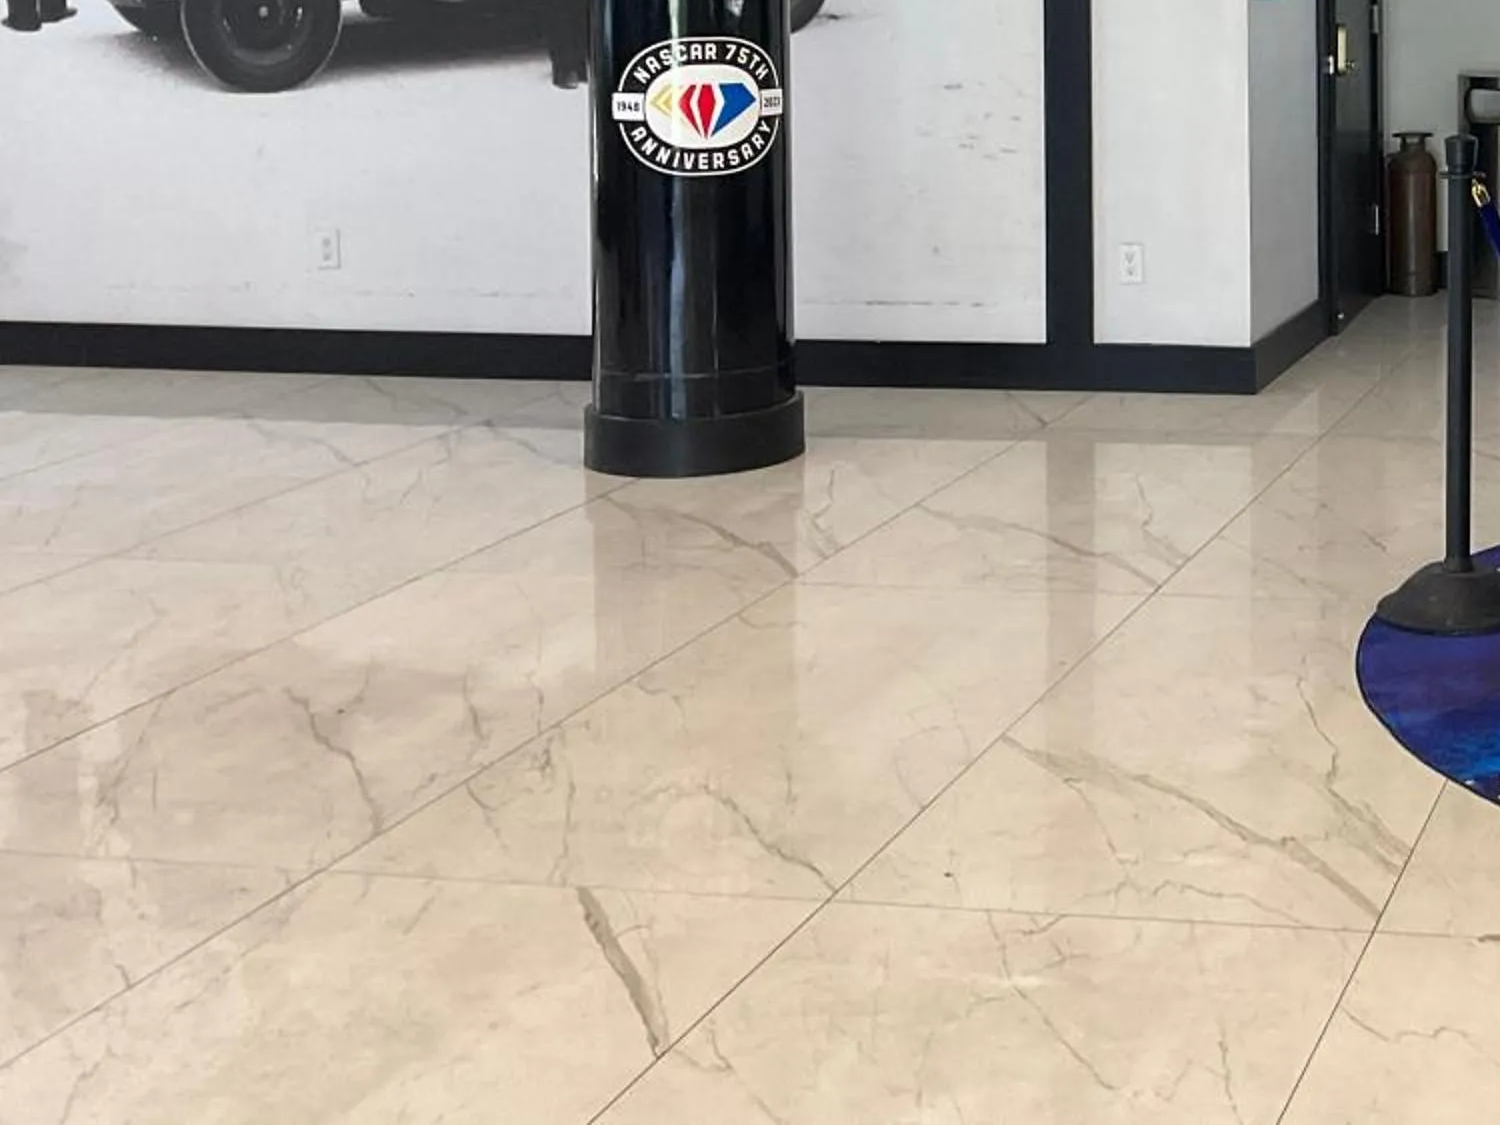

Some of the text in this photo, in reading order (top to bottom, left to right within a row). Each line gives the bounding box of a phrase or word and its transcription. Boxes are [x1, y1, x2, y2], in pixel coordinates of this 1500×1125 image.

[633, 42, 770, 84] NASCAR 75TH
[630, 120, 772, 170] ANNIVERSARY
